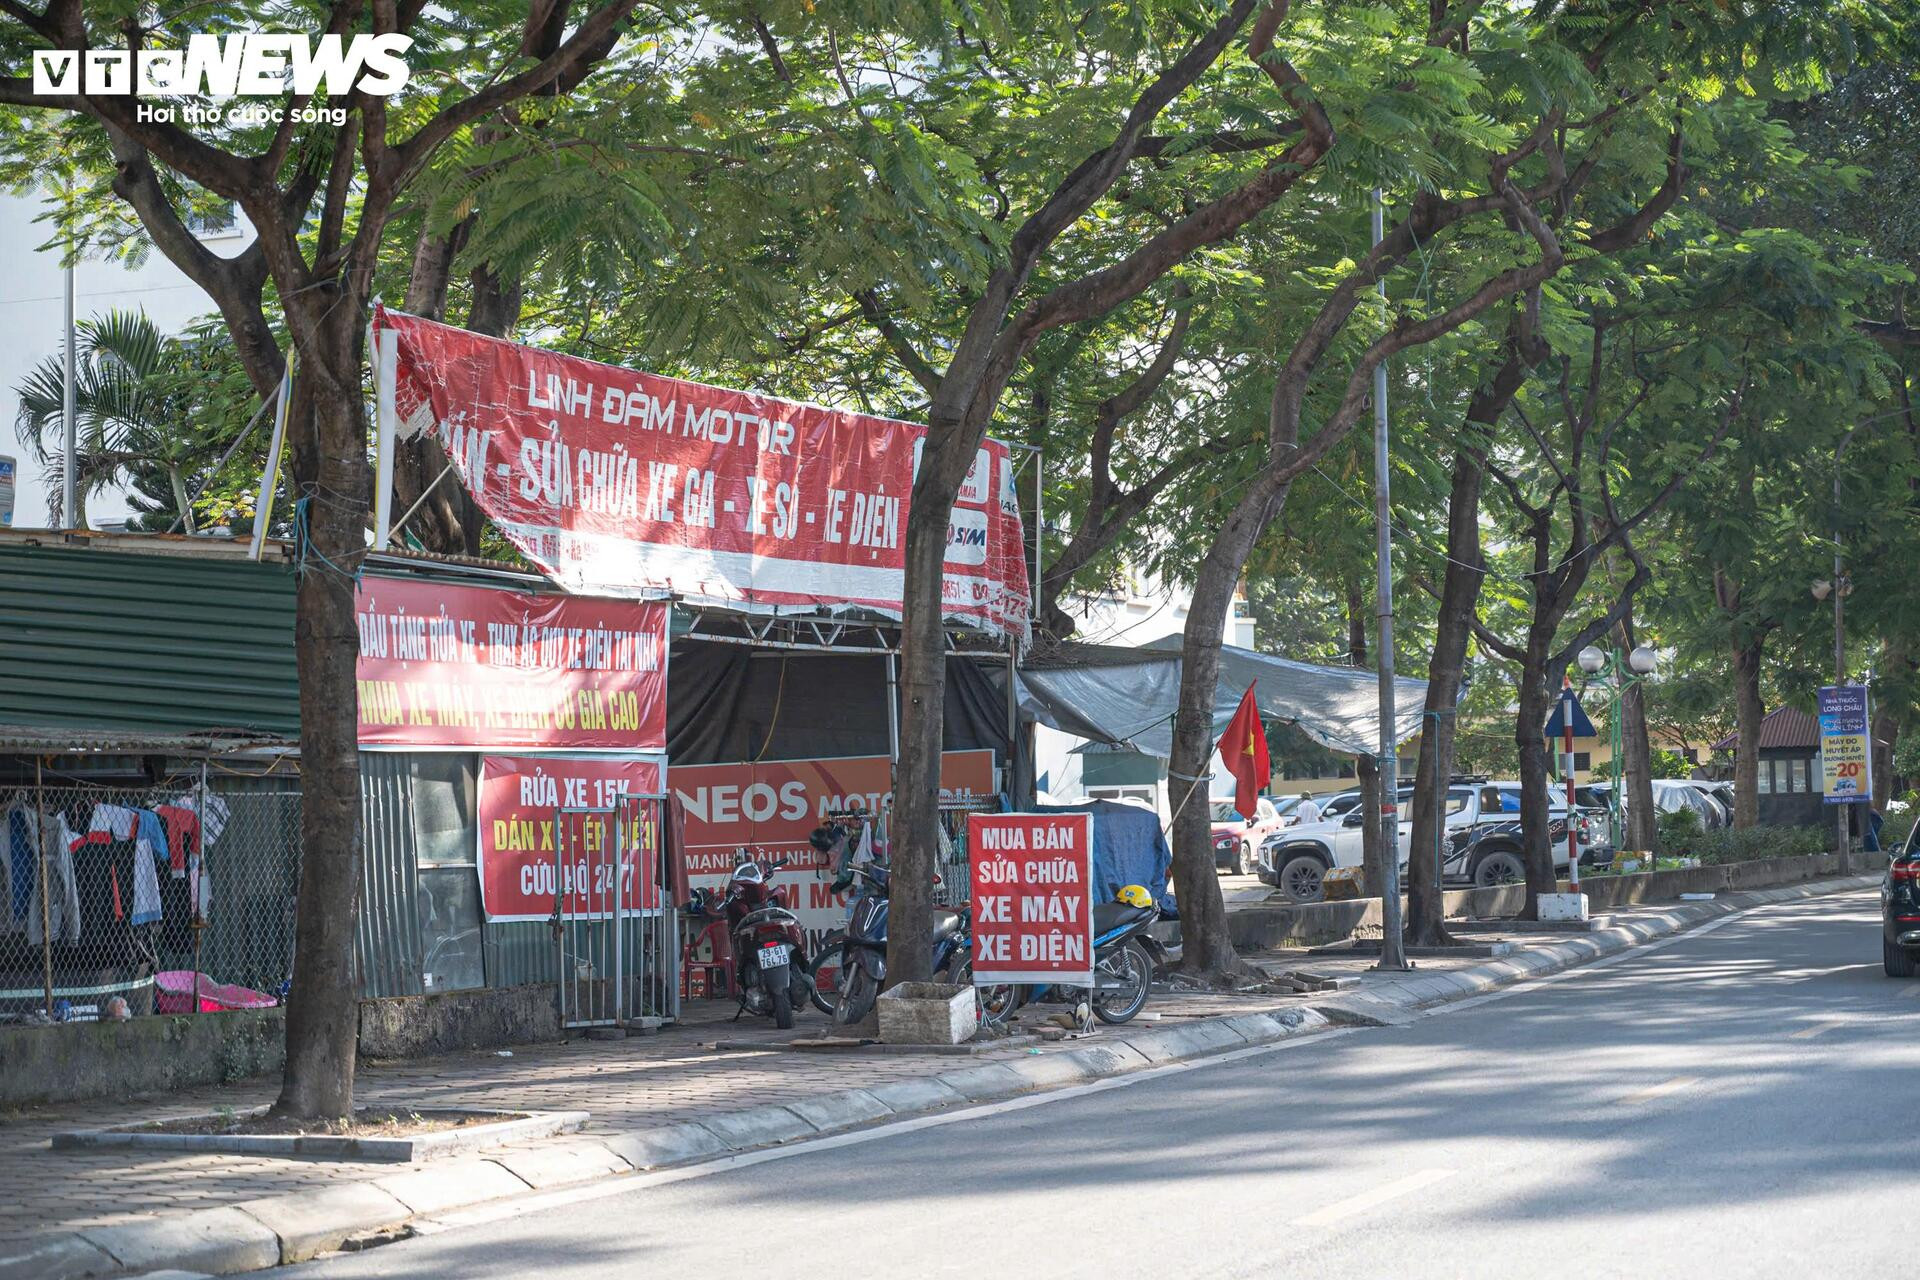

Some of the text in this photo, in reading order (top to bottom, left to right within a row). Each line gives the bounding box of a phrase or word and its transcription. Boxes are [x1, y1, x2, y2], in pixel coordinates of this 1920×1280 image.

[528, 370, 795, 455] LINH ĐÀM MOTOR
[520, 420, 573, 508] SỬA
[578, 442, 637, 519] CHỮA
[644, 461, 678, 522] XE
[683, 467, 715, 528] GA
[745, 476, 767, 535] XE
[823, 488, 846, 543] XE
[955, 527, 986, 546] SYM
[358, 597, 387, 658] DẦU
[390, 606, 427, 669] TẶNG
[429, 604, 458, 662] RỬA
[460, 620, 476, 663] XE
[488, 622, 518, 666] THAY
[567, 628, 583, 668] XE
[635, 624, 658, 671] NHÀ
[357, 680, 404, 725] MUA
[404, 682, 432, 725] XE
[483, 686, 507, 728] XE
[578, 682, 606, 730] GIÁ
[608, 691, 639, 731] CAO
[520, 766, 630, 808] RỬA XE 15K
[667, 781, 808, 824] NEOS
[494, 814, 534, 851] DÁN
[540, 821, 564, 851] XE
[982, 823, 1074, 849] MUA BÁN
[521, 858, 634, 901] CỨU HỘ 247
[979, 853, 1078, 883] SỬA CHỮA
[978, 890, 1080, 922] XE MÁY
[978, 929, 1084, 967] XE ĐIỆN
